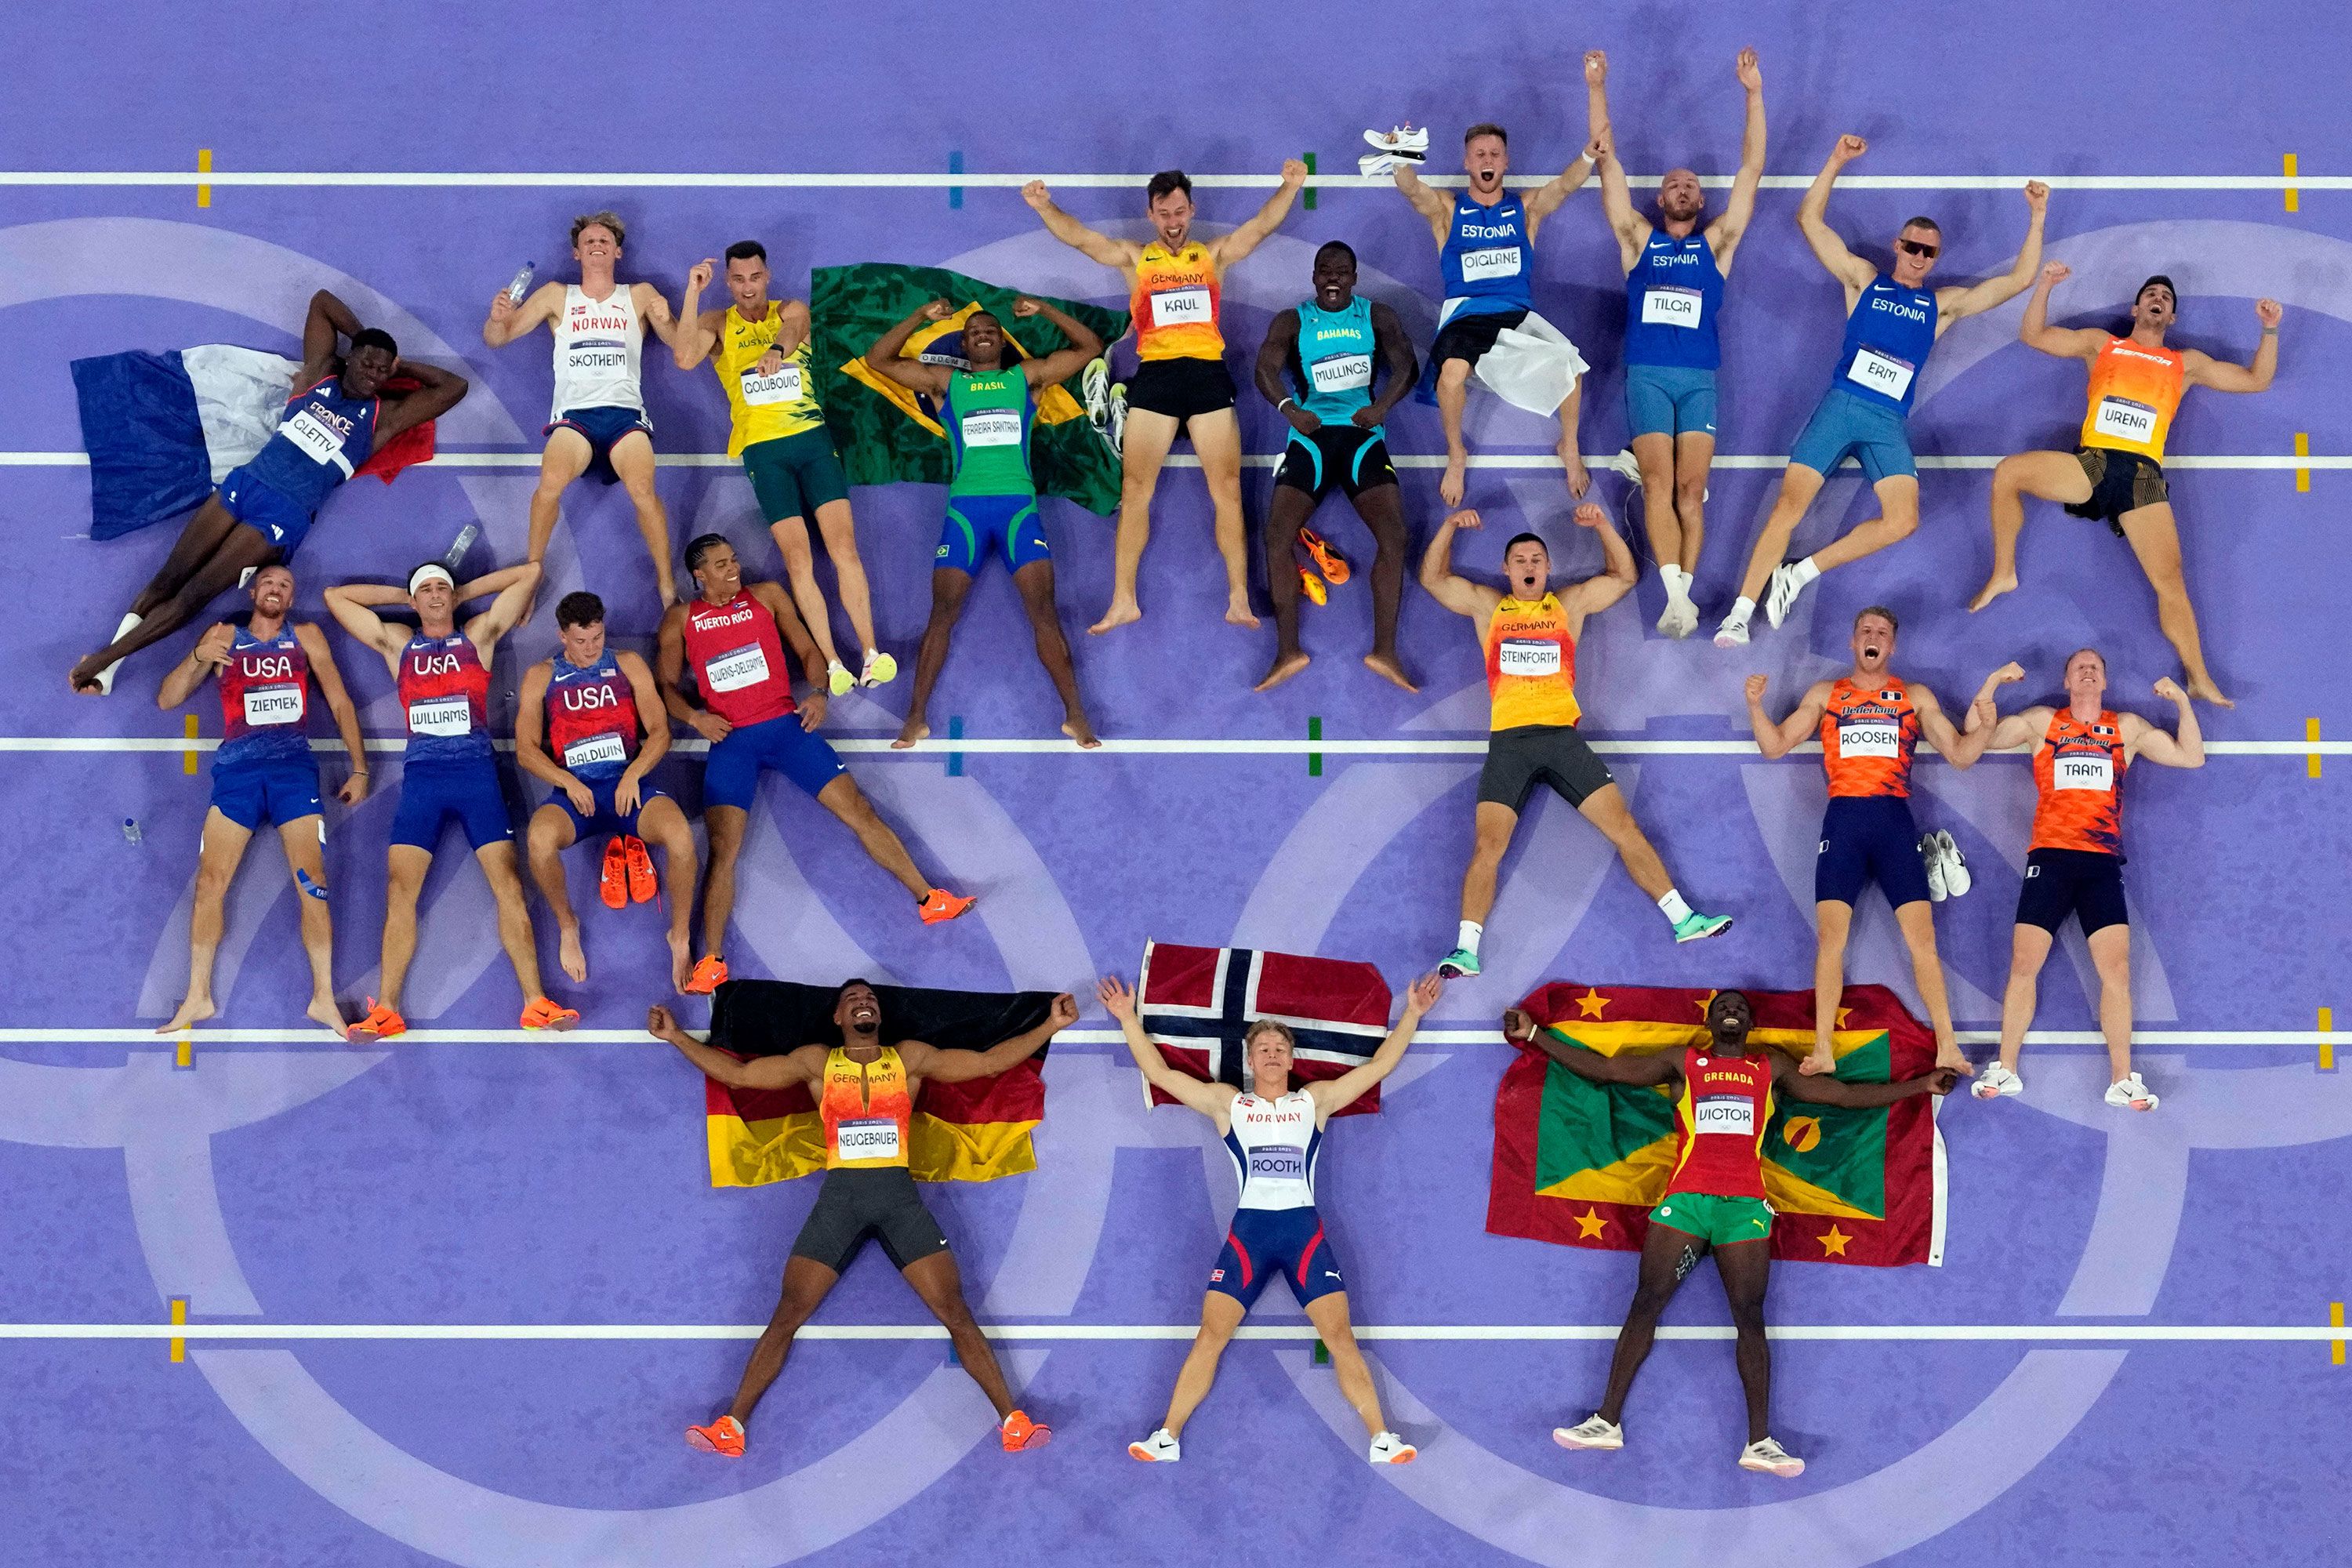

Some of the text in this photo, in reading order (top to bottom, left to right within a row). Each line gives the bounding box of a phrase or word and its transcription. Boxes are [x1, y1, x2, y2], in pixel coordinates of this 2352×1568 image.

[1462, 223, 1516, 238] ESTONIA
[1465, 252, 1517, 267] OIGLANE
[1151, 274, 1204, 283] GERMANY
[1165, 299, 1199, 312] KAUL
[1654, 298, 1691, 314] TILGA
[1872, 298, 1926, 323] ESTONIA
[573, 318, 627, 332] NORWAY
[1317, 328, 1361, 340] BAHAMAS
[569, 354, 626, 367] SKOTHEIM
[922, 354, 958, 365] ORDEM
[1316, 362, 1368, 383] MULLINGS
[1867, 361, 1897, 383] ERM
[745, 376, 799, 394] GOLUBOVIC
[971, 382, 1006, 391] BRASIL
[310, 401, 354, 436] FRANCE
[2105, 409, 2147, 430] URENA
[964, 421, 1018, 435] FERREIRA SANTANA
[695, 609, 753, 632] PUERTO RICO
[1502, 621, 1556, 631] GERMANY
[414, 654, 461, 674] USA
[1502, 651, 1557, 663] STEINFORTH
[243, 656, 292, 677] USA
[710, 655, 764, 683] OWENS-DELERME
[251, 696, 298, 712] ZIEMEK
[564, 685, 618, 711] USA
[412, 710, 467, 724] WILLIAMS
[1842, 706, 1898, 714] Nederland
[1842, 731, 1896, 745] ROOSEN
[568, 745, 622, 765] BALDWIN
[1704, 1072, 1753, 1085] GRENADA
[1247, 1112, 1301, 1123] NORWAY
[1700, 1109, 1751, 1122] VICTOR
[840, 1132, 897, 1146] NEUGEBAUER
[1253, 1160, 1301, 1173] ROOTH
